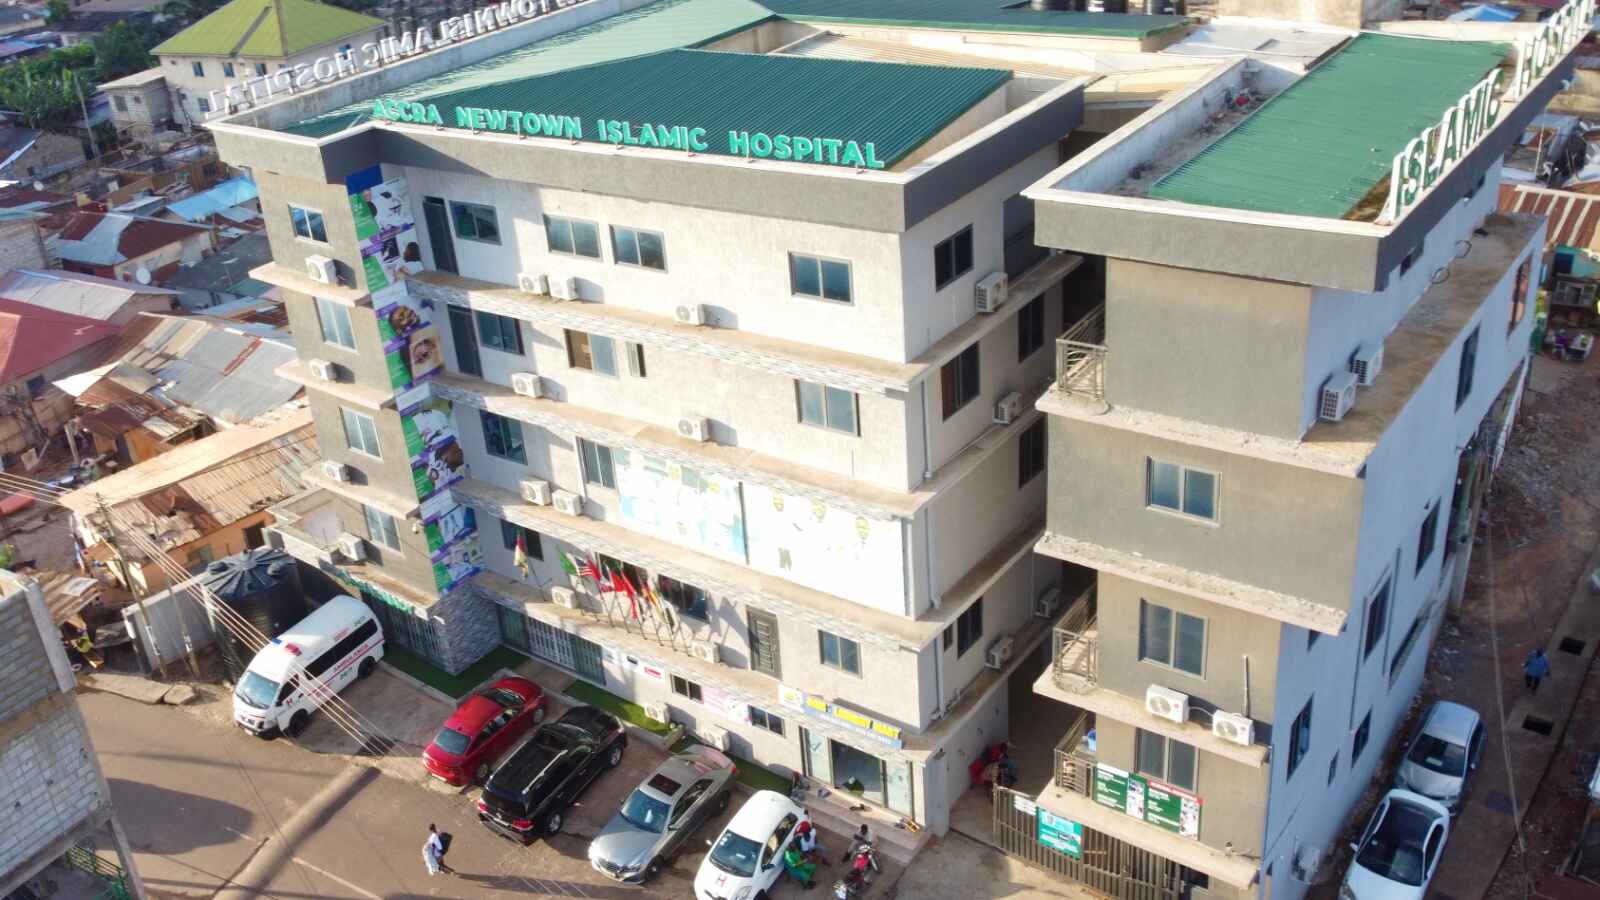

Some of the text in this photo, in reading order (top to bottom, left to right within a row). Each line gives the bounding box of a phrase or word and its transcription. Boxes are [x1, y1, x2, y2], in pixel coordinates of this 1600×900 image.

[373, 98, 885, 169] ACCRA NEWTOWN ISLAMIC HOSPITAL
[1389, 67, 1504, 220] ISLAMIC
